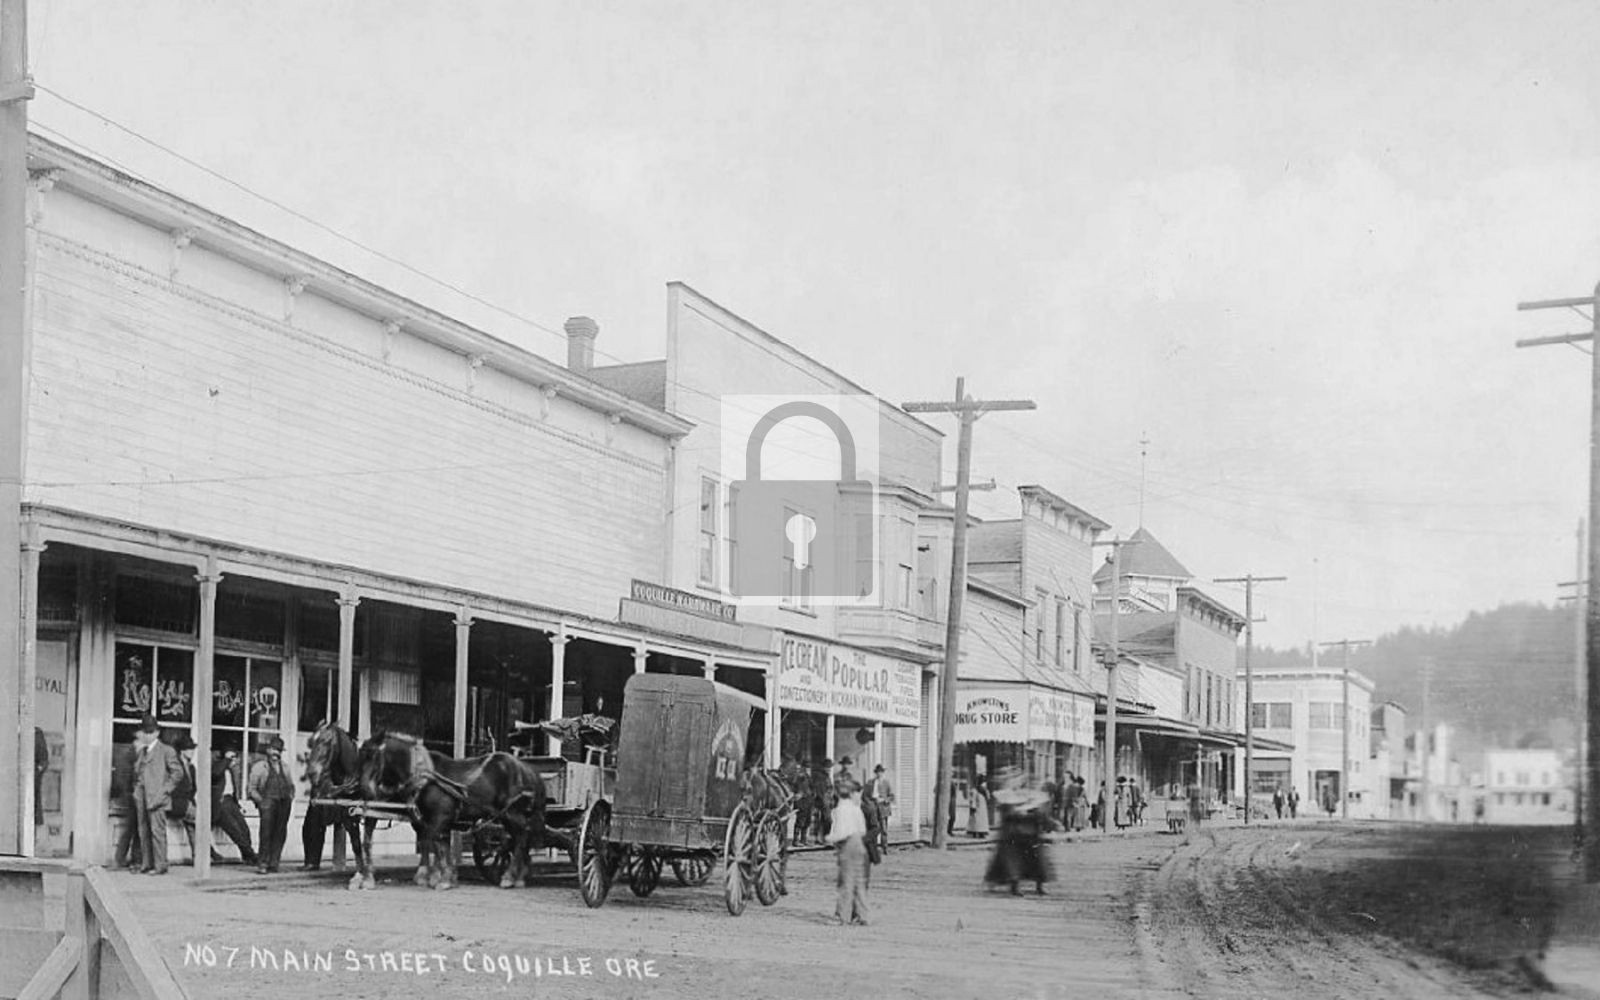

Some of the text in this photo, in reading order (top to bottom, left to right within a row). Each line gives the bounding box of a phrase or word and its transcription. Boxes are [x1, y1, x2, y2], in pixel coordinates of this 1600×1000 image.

[634, 583, 676, 604] COQUILLE
[780, 637, 829, 682] ICE CREAM
[35, 676, 65, 696] OYAL
[980, 711, 1019, 725] STORE
